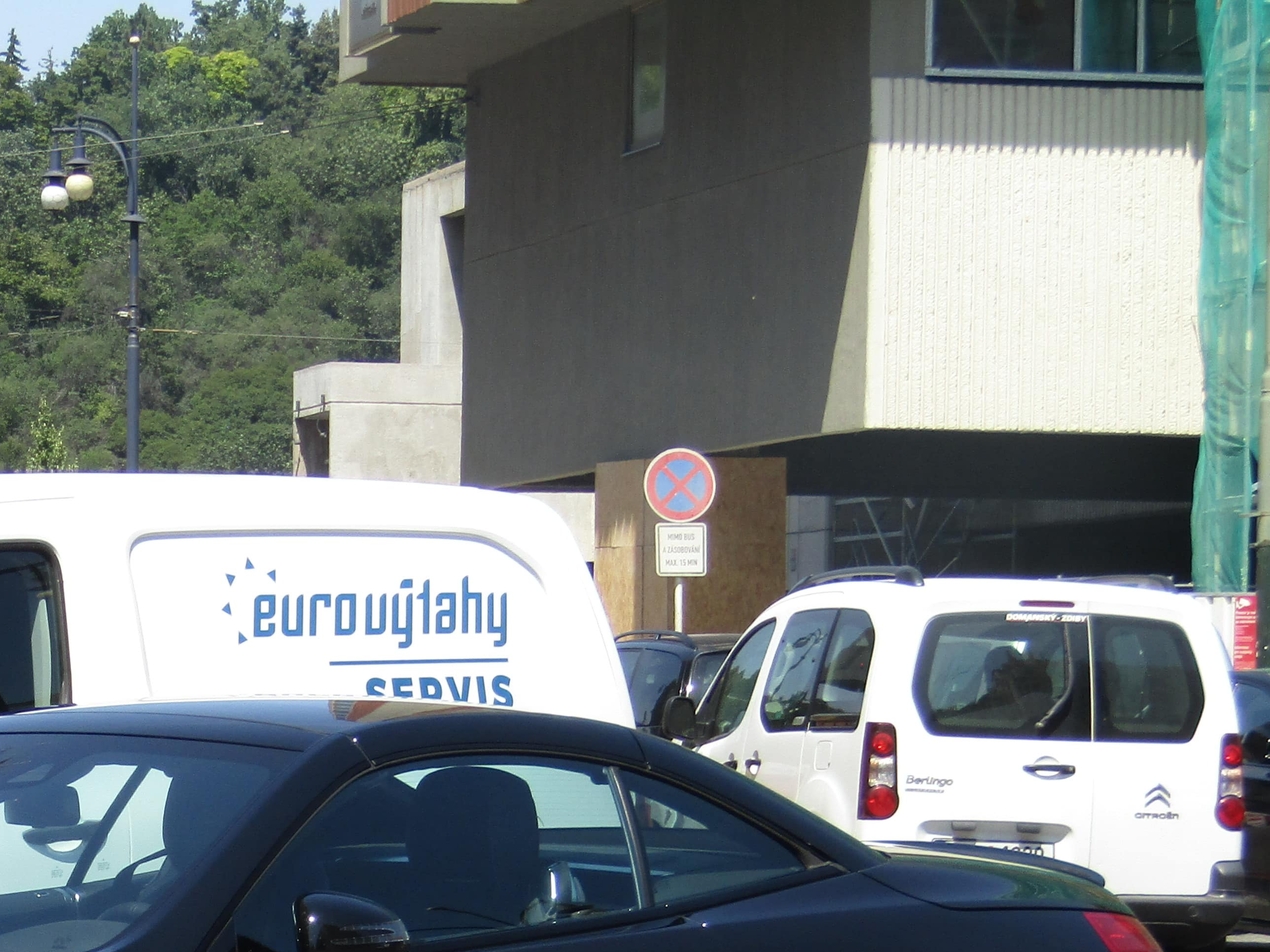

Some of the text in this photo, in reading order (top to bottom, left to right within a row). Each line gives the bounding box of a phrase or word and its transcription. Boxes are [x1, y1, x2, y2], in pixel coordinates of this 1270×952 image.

[667, 533, 695, 541] MIMO BUS
[679, 559, 687, 567] 15
[687, 559, 698, 567] MIN
[253, 575, 507, 649] eurovýtahy
[906, 775, 953, 787] Berlingo
